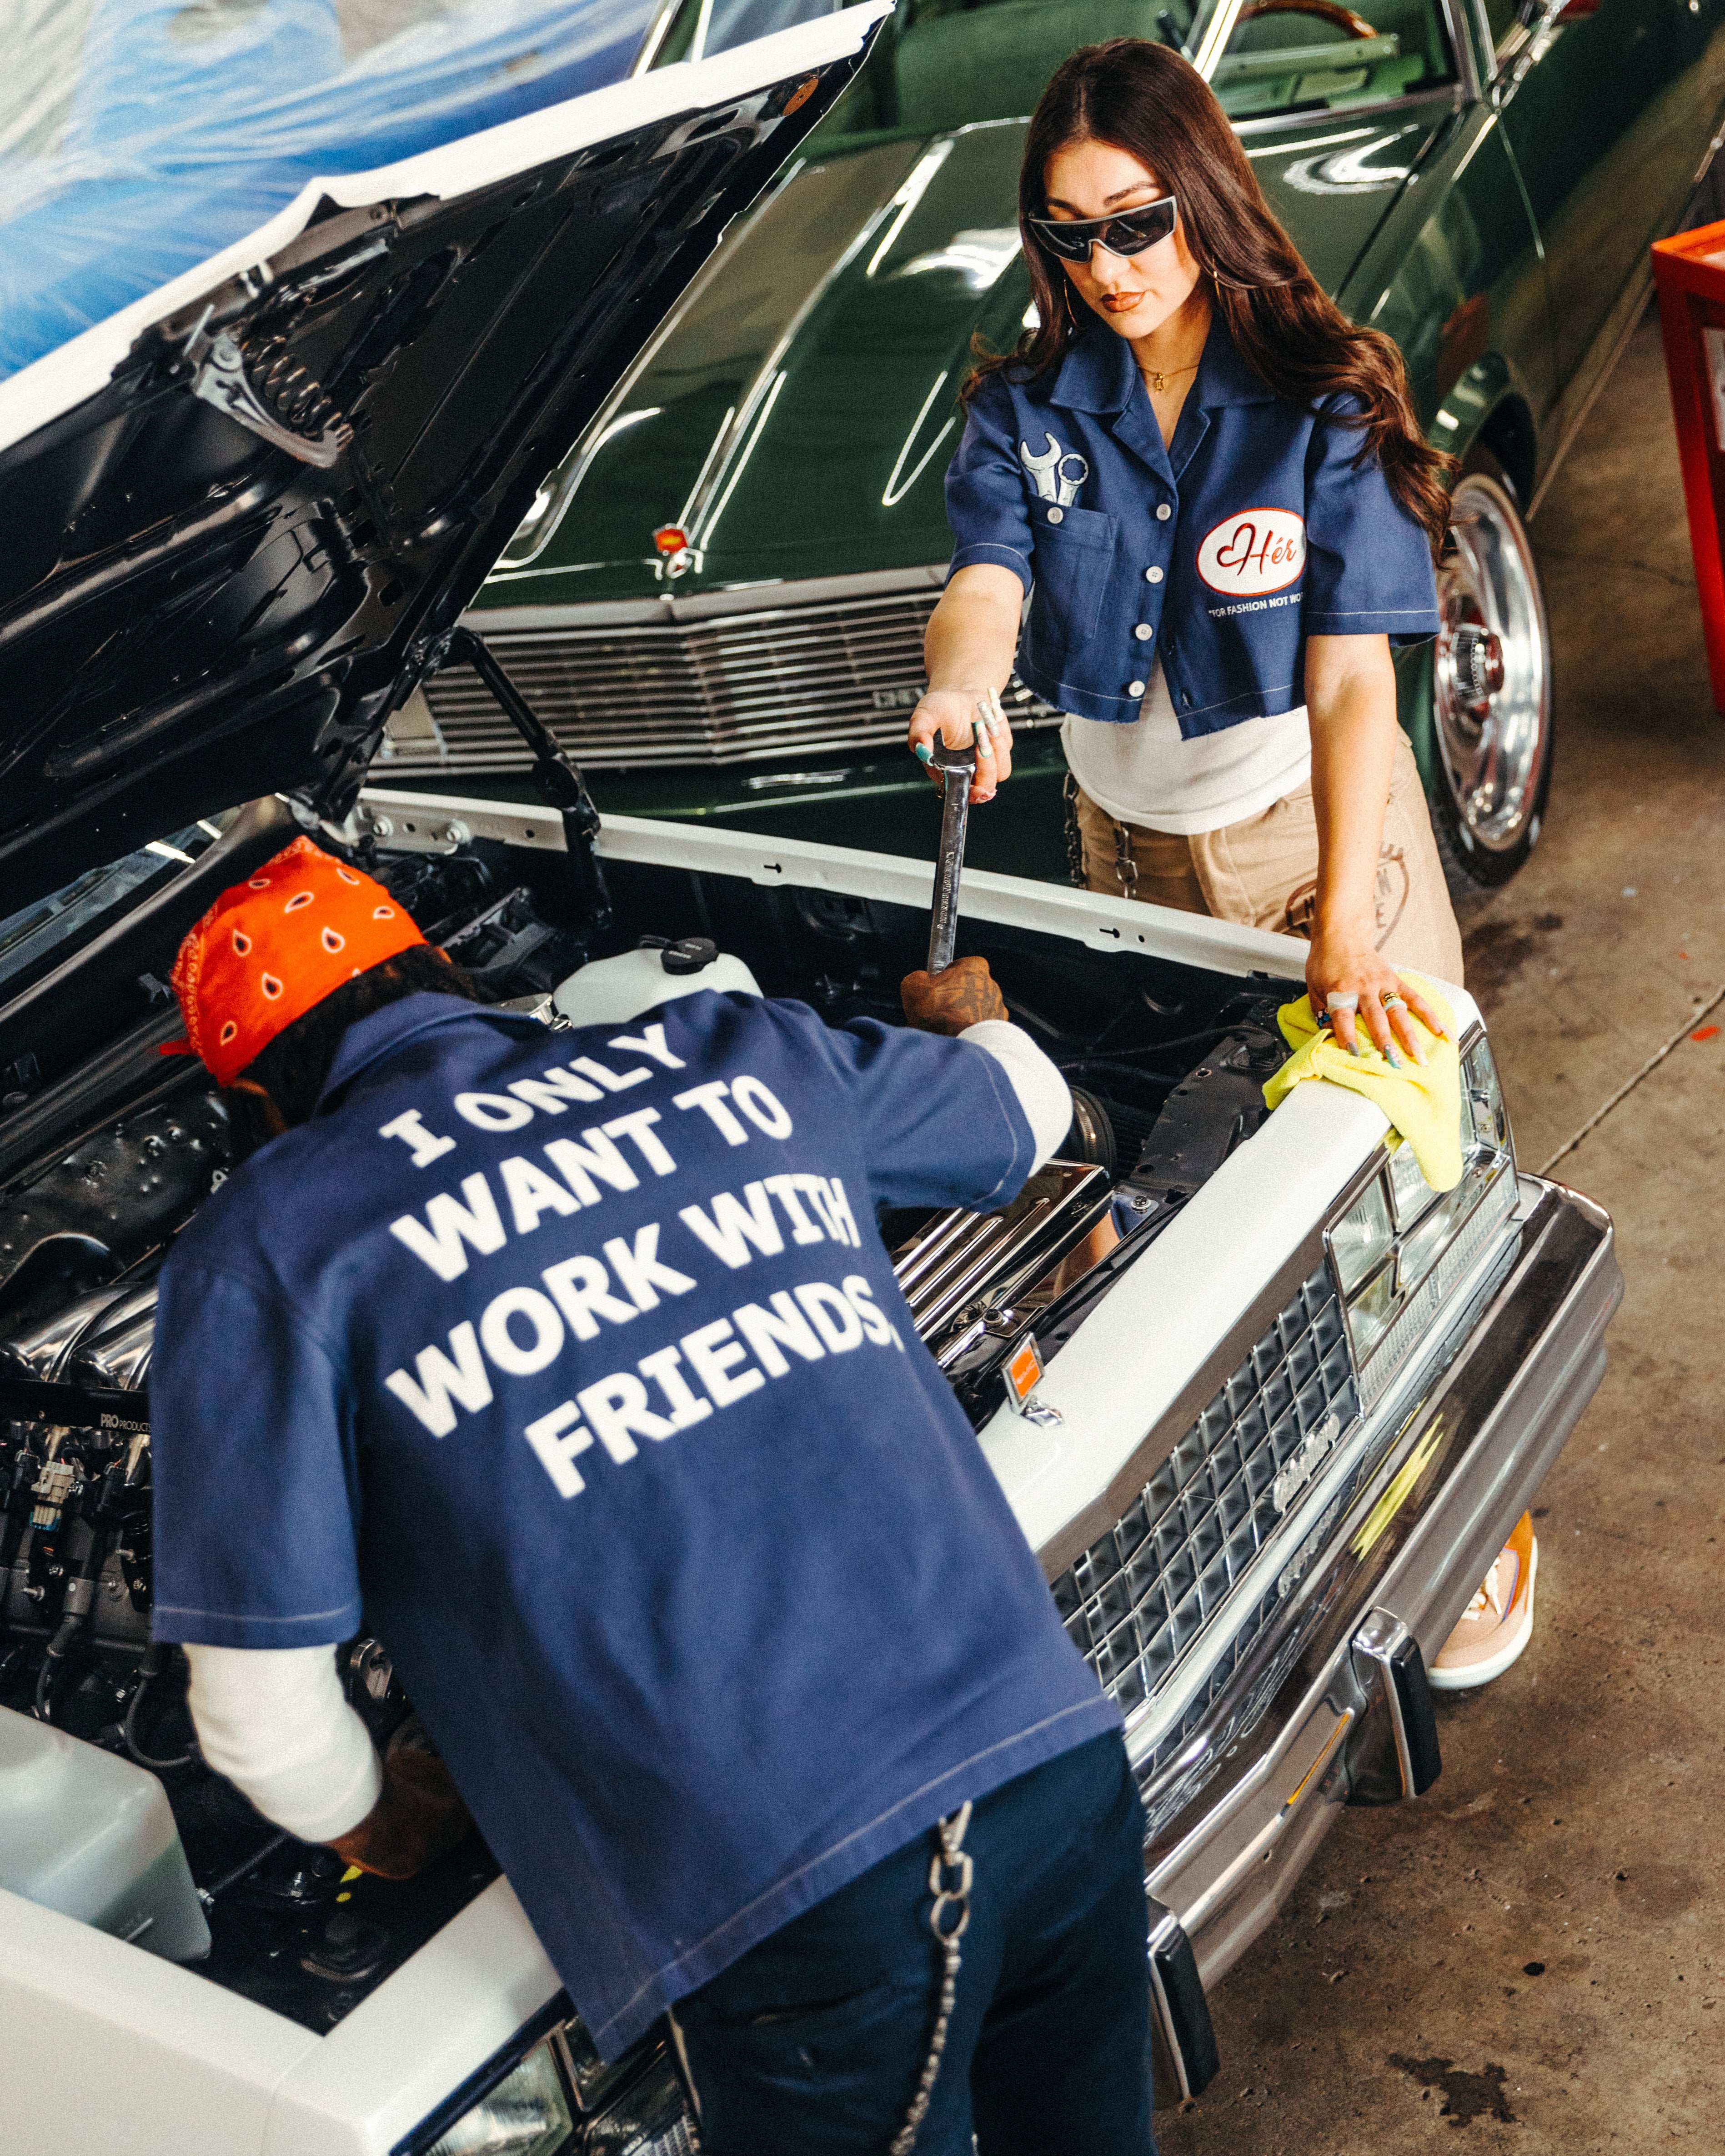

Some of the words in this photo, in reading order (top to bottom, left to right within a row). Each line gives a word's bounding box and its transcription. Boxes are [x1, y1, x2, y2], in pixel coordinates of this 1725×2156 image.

[1216, 522, 1297, 576] Hér
[1227, 600, 1268, 615] FASHION
[1269, 595, 1289, 608] NOT
[380, 1109, 455, 1167] I
[455, 1024, 686, 1131] ONLY
[390, 1107, 677, 1282] WANT
[673, 1075, 793, 1146] TO
[385, 1223, 697, 1438] WORK
[679, 1173, 862, 1269] WITH
[100, 1413, 118, 1428] PRO
